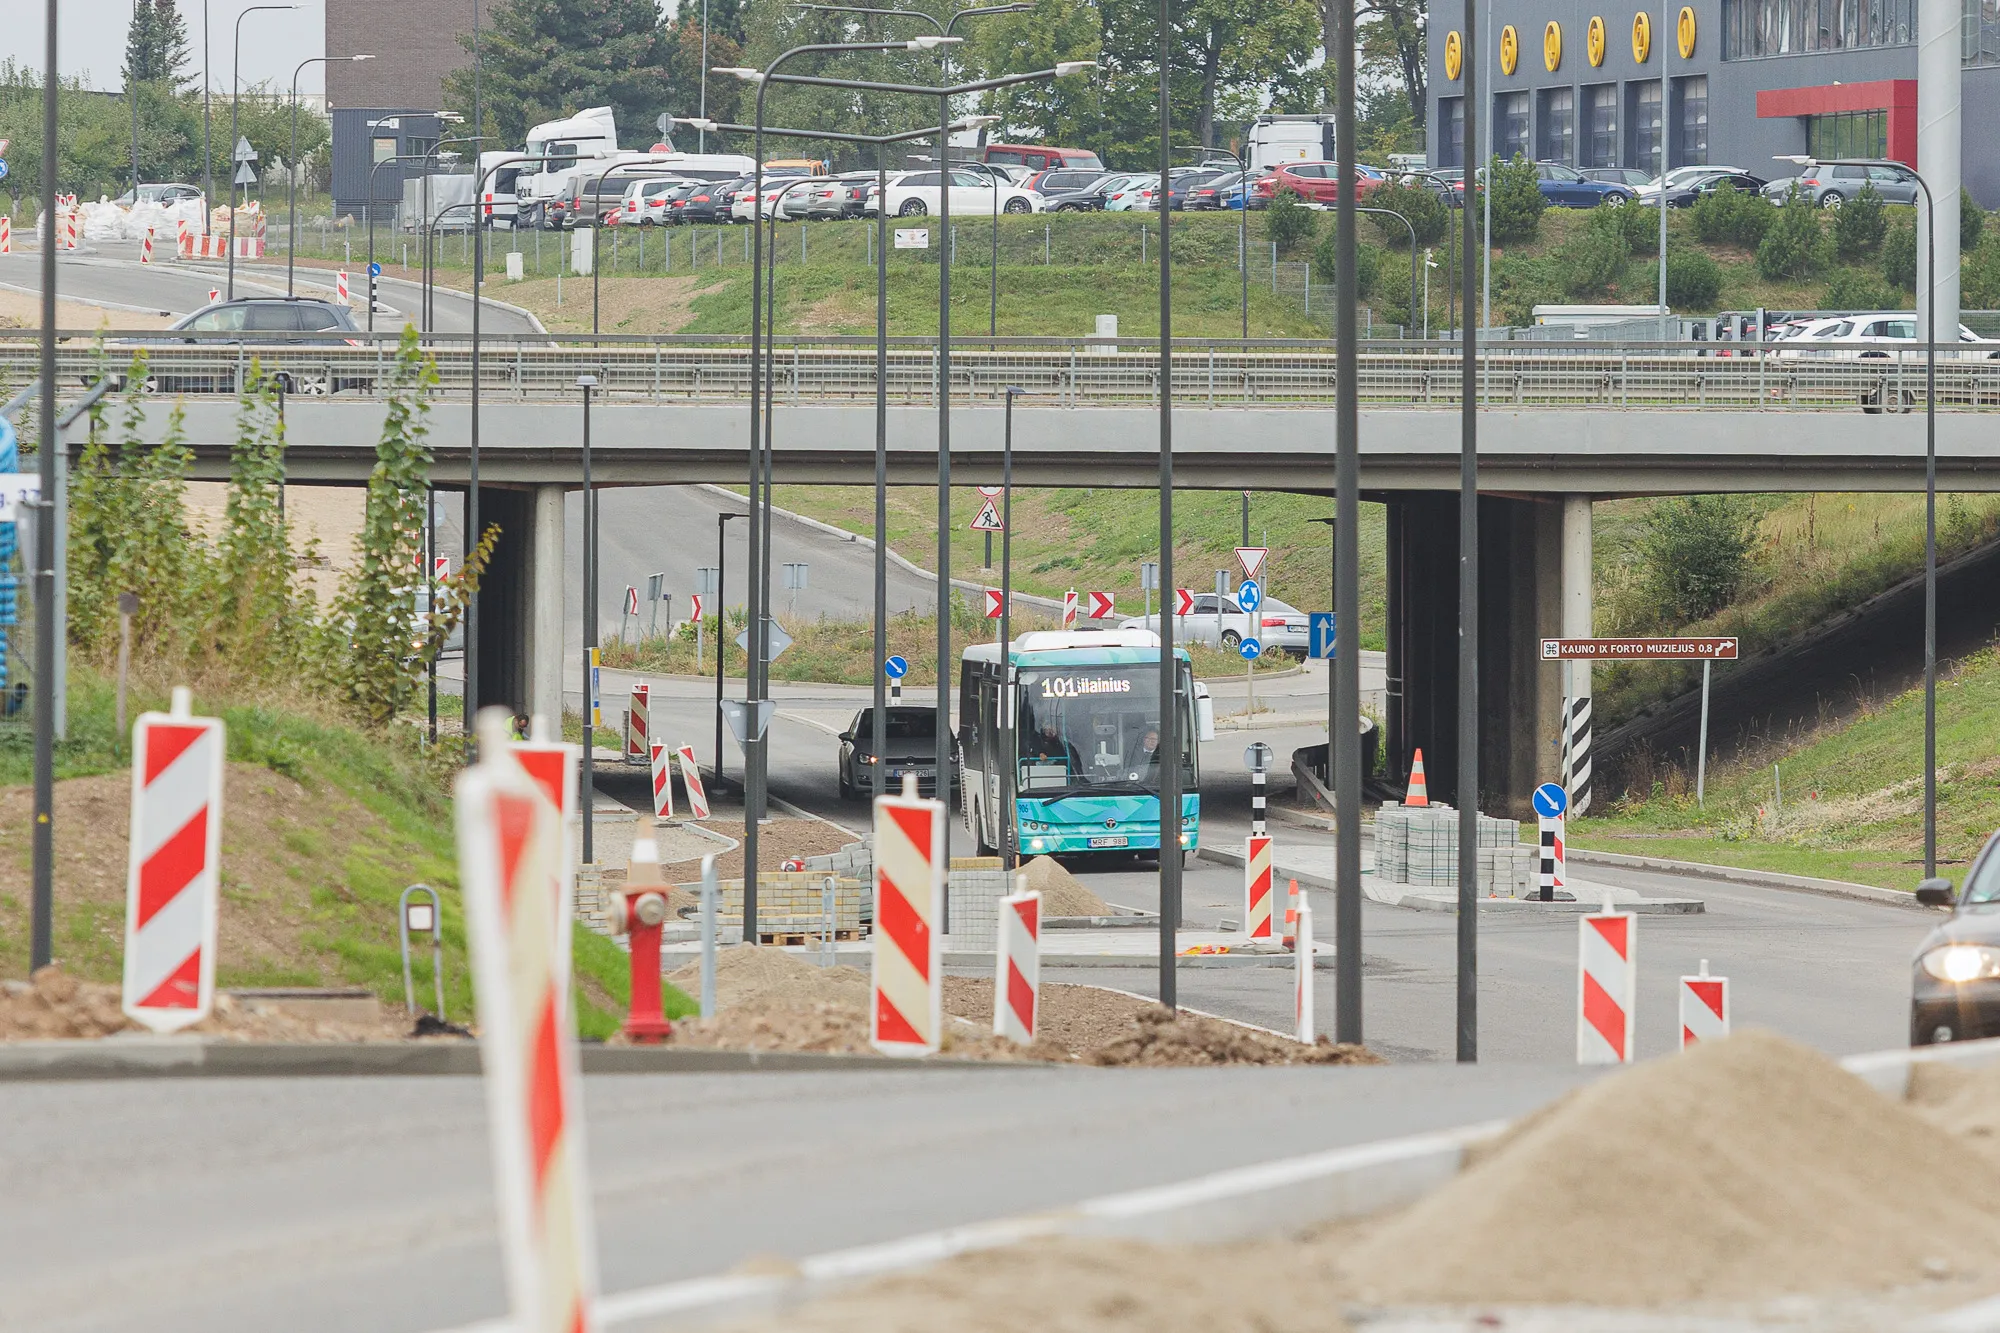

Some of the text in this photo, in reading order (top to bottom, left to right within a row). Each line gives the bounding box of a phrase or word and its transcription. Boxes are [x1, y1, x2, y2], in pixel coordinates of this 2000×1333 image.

[1561, 643, 1713, 654] KAUNO IX FORTO MUZIEJUS 0,8
[1042, 677, 1078, 697] 101
